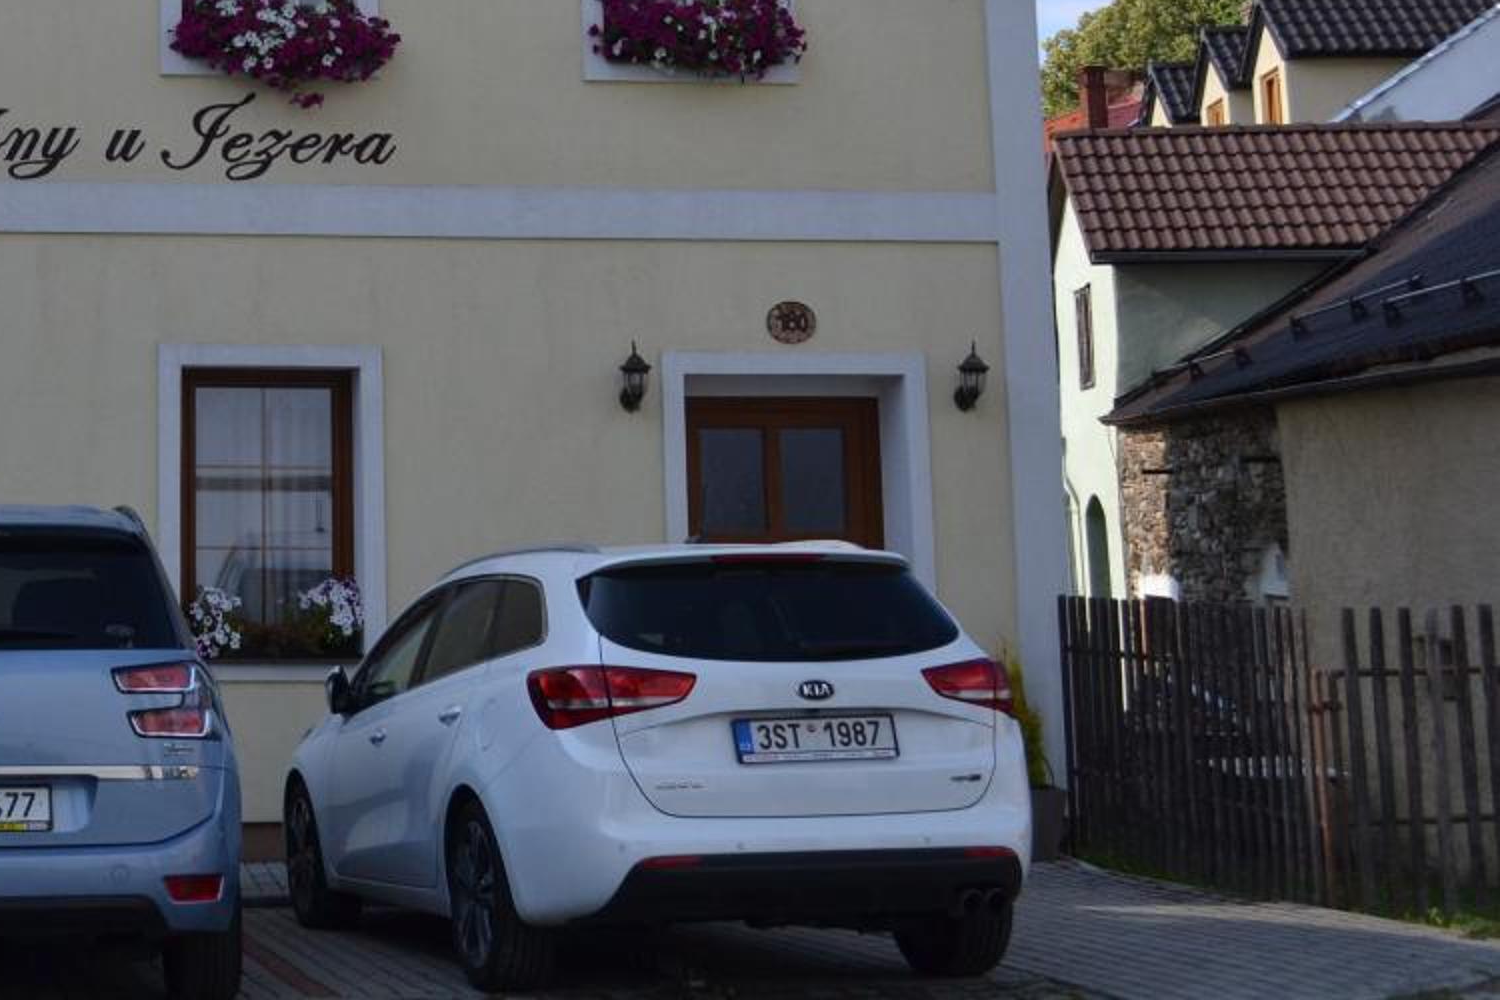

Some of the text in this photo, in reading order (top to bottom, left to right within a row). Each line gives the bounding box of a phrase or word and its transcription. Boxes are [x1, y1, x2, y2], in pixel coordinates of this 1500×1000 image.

[105, 130, 146, 163] u
[160, 91, 397, 181] Jezera
[803, 682, 831, 697] KIA
[756, 720, 880, 750] 3ST 1987
